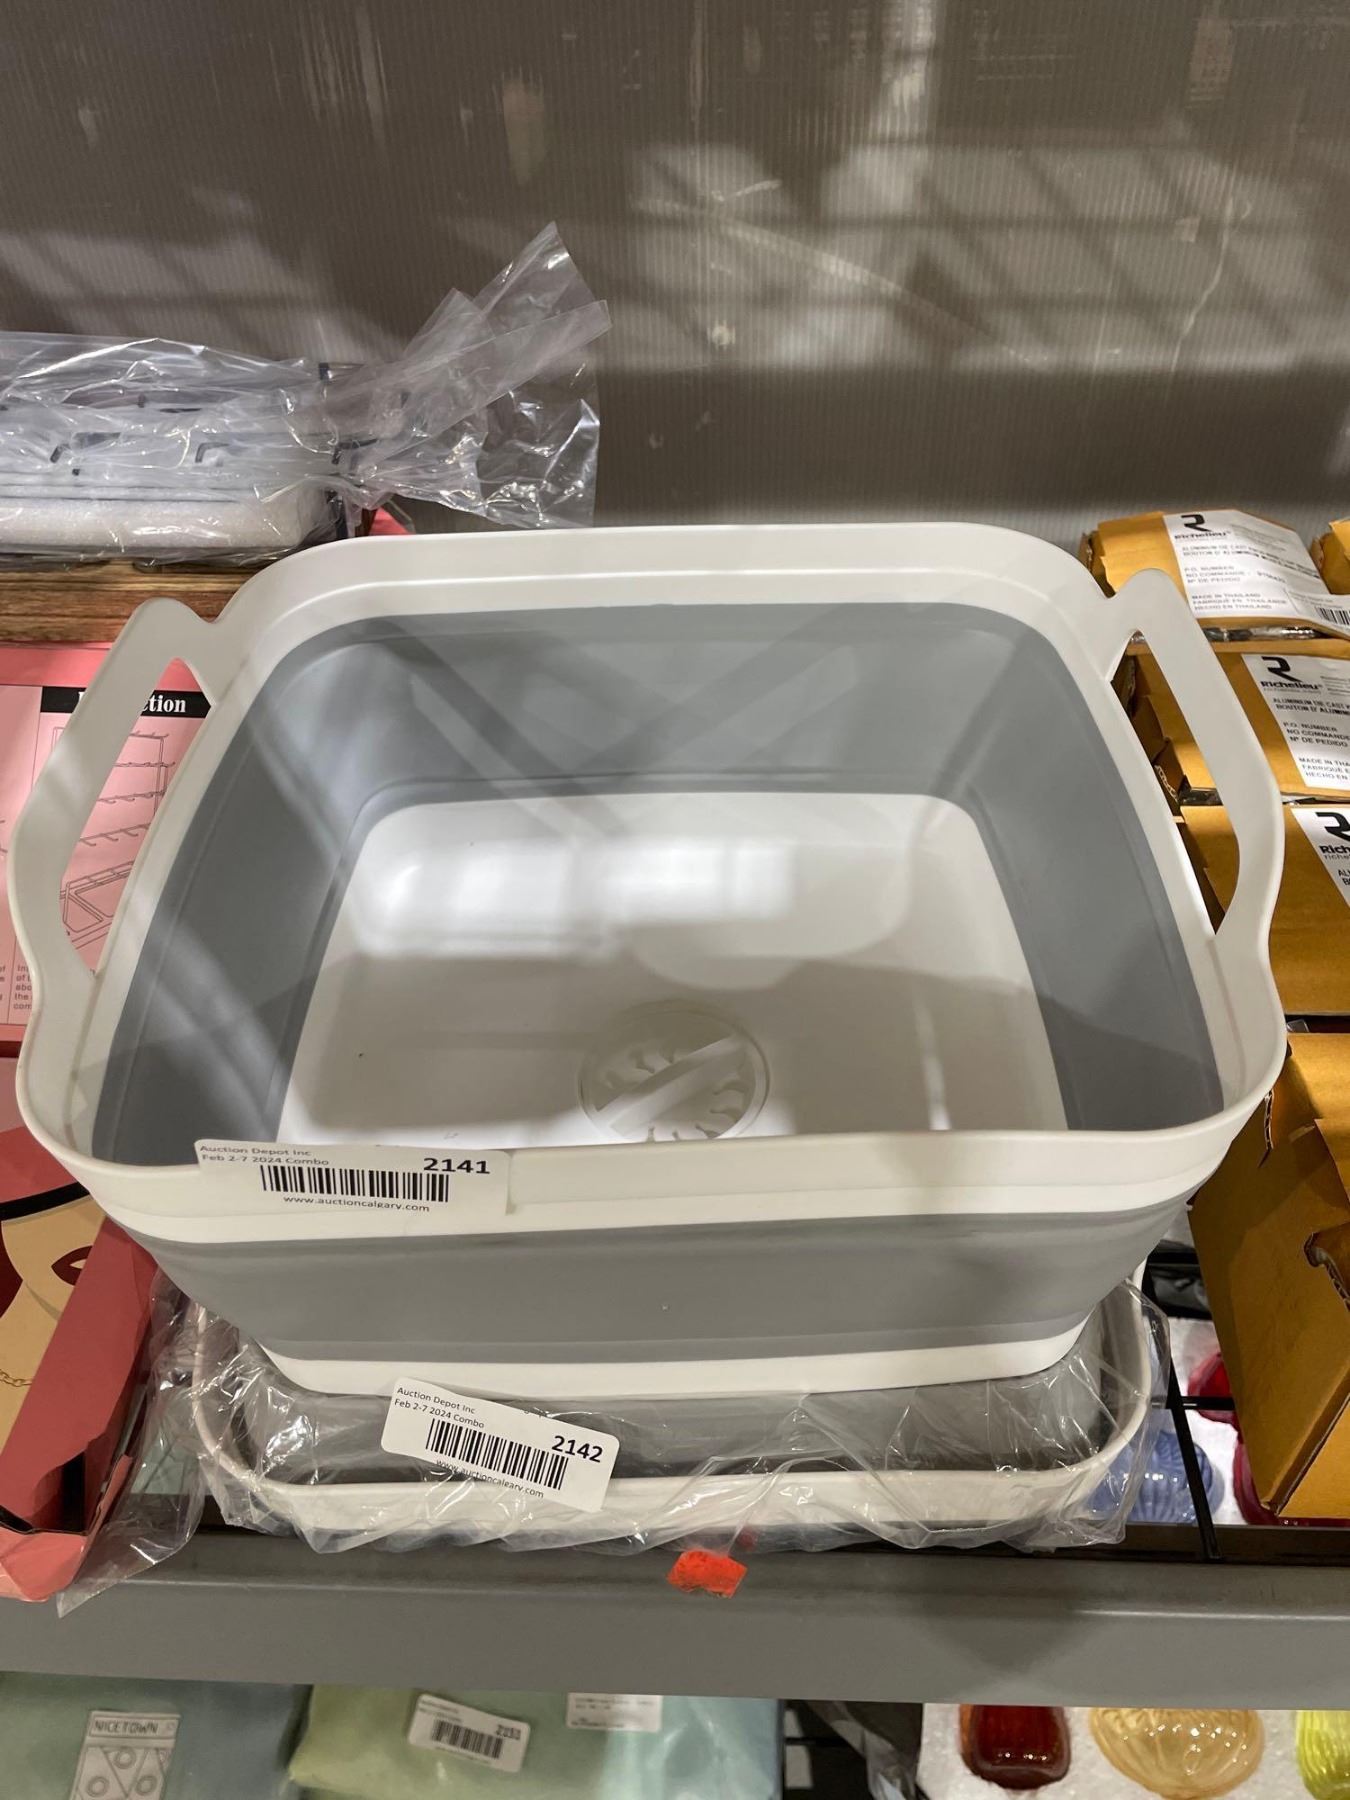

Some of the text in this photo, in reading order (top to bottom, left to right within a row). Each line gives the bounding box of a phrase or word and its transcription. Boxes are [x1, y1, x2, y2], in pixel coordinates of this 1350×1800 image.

[1260, 681, 1319, 690] Richelieu
[200, 1145, 312, 1157] Auction Depot Inc
[202, 1154, 225, 1162] Feb
[251, 1156, 282, 1164] 2024
[284, 1157, 329, 1166] Combo
[423, 1157, 490, 1174] 2141
[396, 1386, 475, 1414] Auction Depot Inc
[394, 1398, 485, 1429] Feb 2-7 2024 Combo
[551, 1435, 604, 1463] 2142
[95, 1720, 159, 1734] NICETOWN
